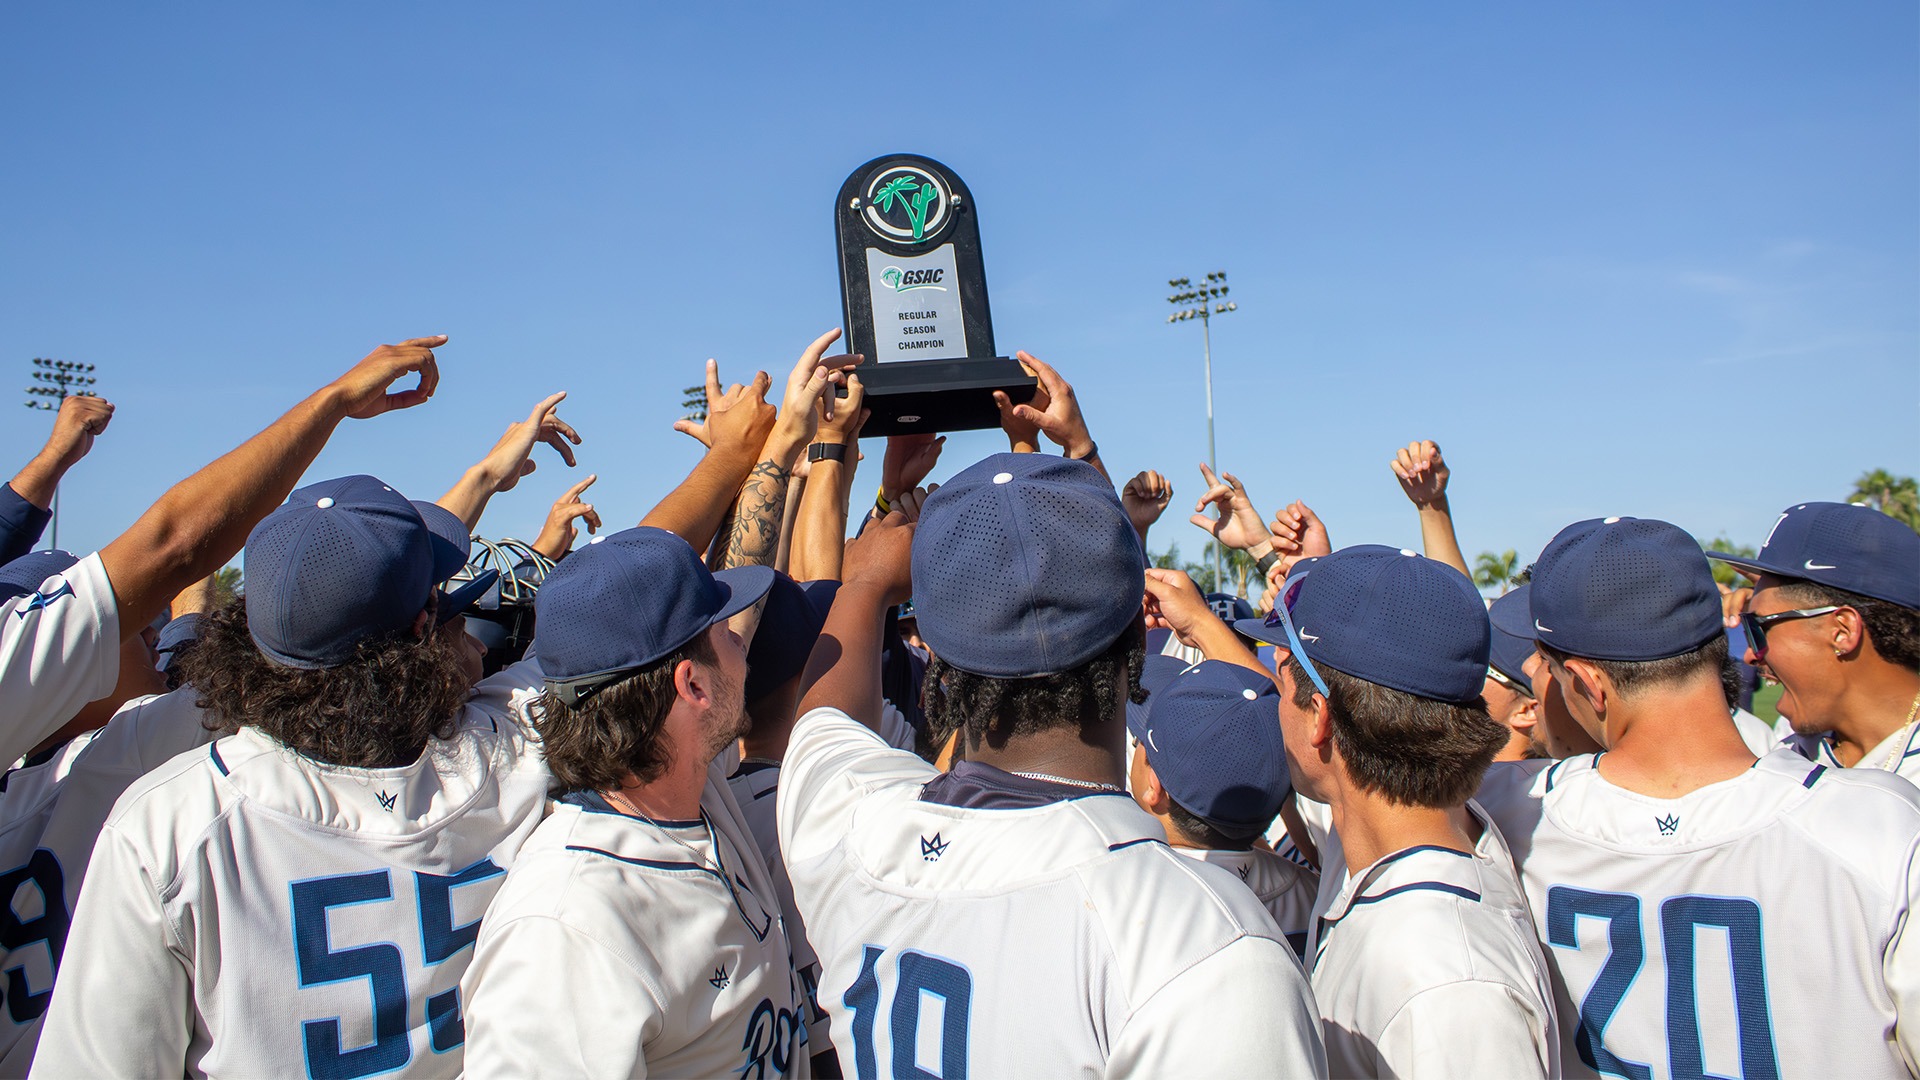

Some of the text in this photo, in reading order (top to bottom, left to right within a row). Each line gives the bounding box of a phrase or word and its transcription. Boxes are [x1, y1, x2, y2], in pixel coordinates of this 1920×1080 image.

[902, 268, 944, 286] GSAC
[898, 310, 938, 321] REGULAR
[902, 325, 936, 335] SEASON
[898, 339, 945, 350] CHAMPION
[288, 855, 508, 1080] 55
[1546, 883, 1783, 1080] 20
